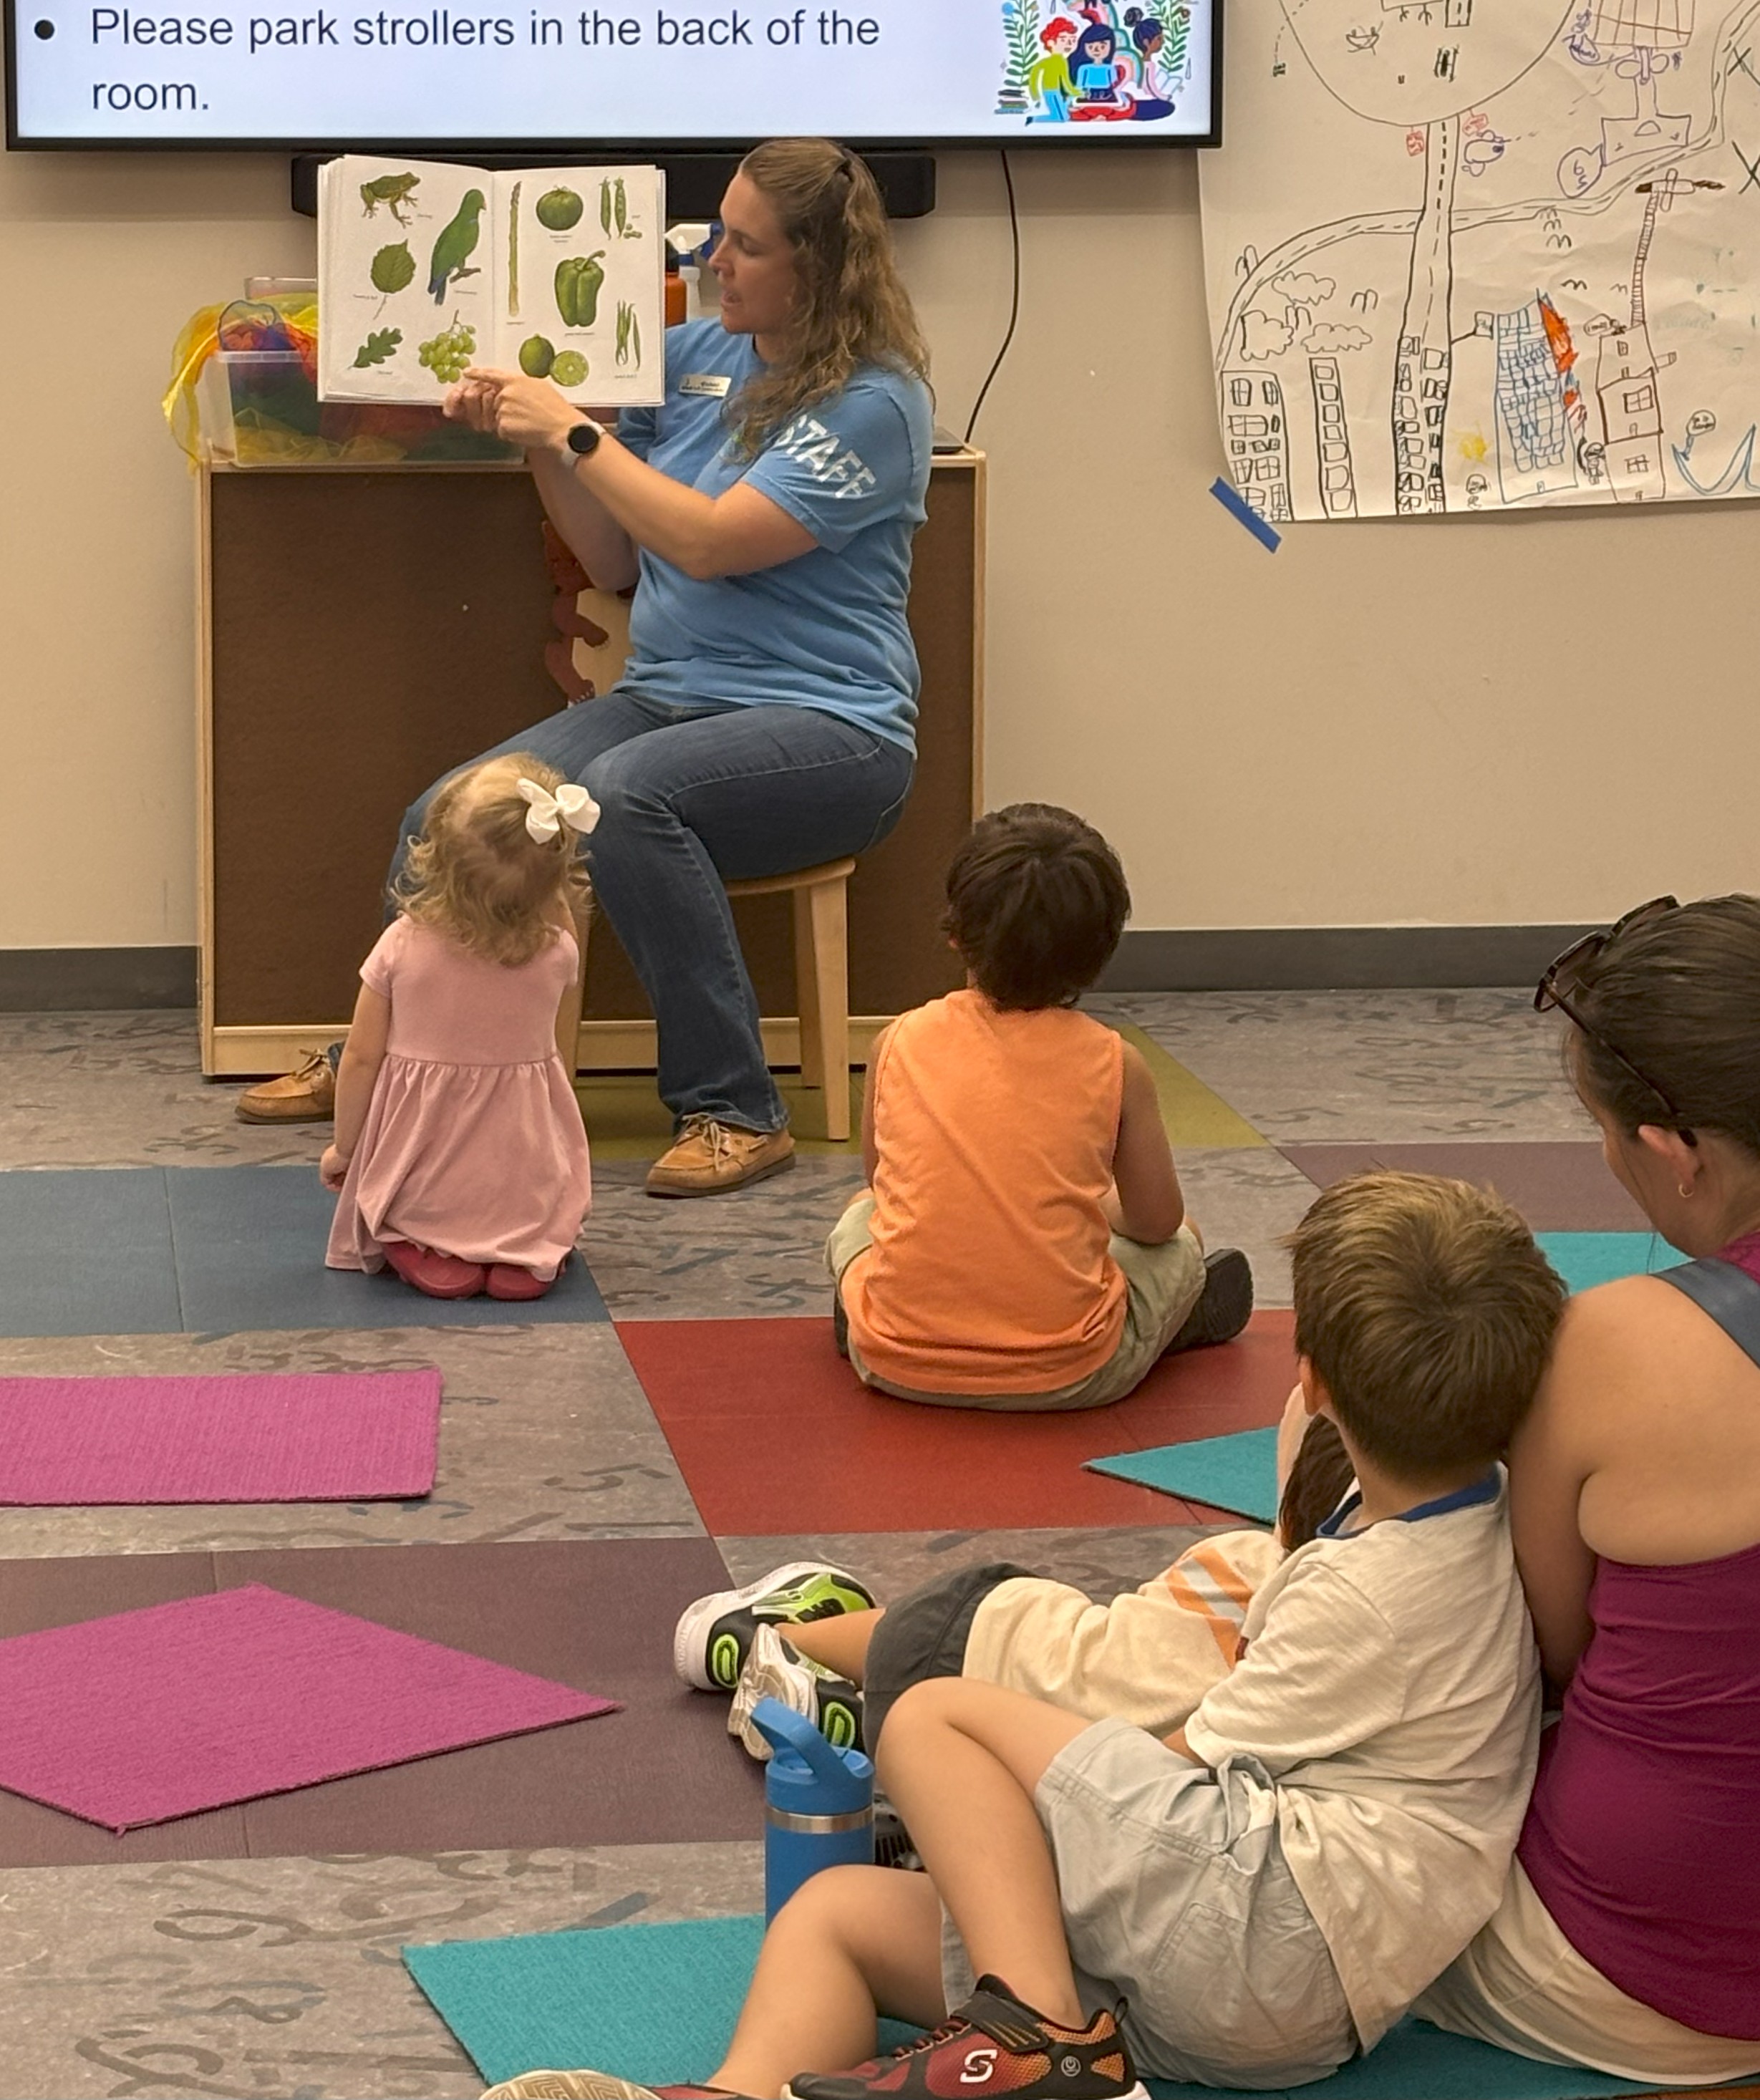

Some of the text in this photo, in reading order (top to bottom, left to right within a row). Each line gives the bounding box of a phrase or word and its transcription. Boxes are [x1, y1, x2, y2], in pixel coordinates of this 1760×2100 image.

[92, 9, 880, 54] Please park strollers in the back of the
[92, 83, 208, 111] room.
[774, 414, 877, 498] STAFF
